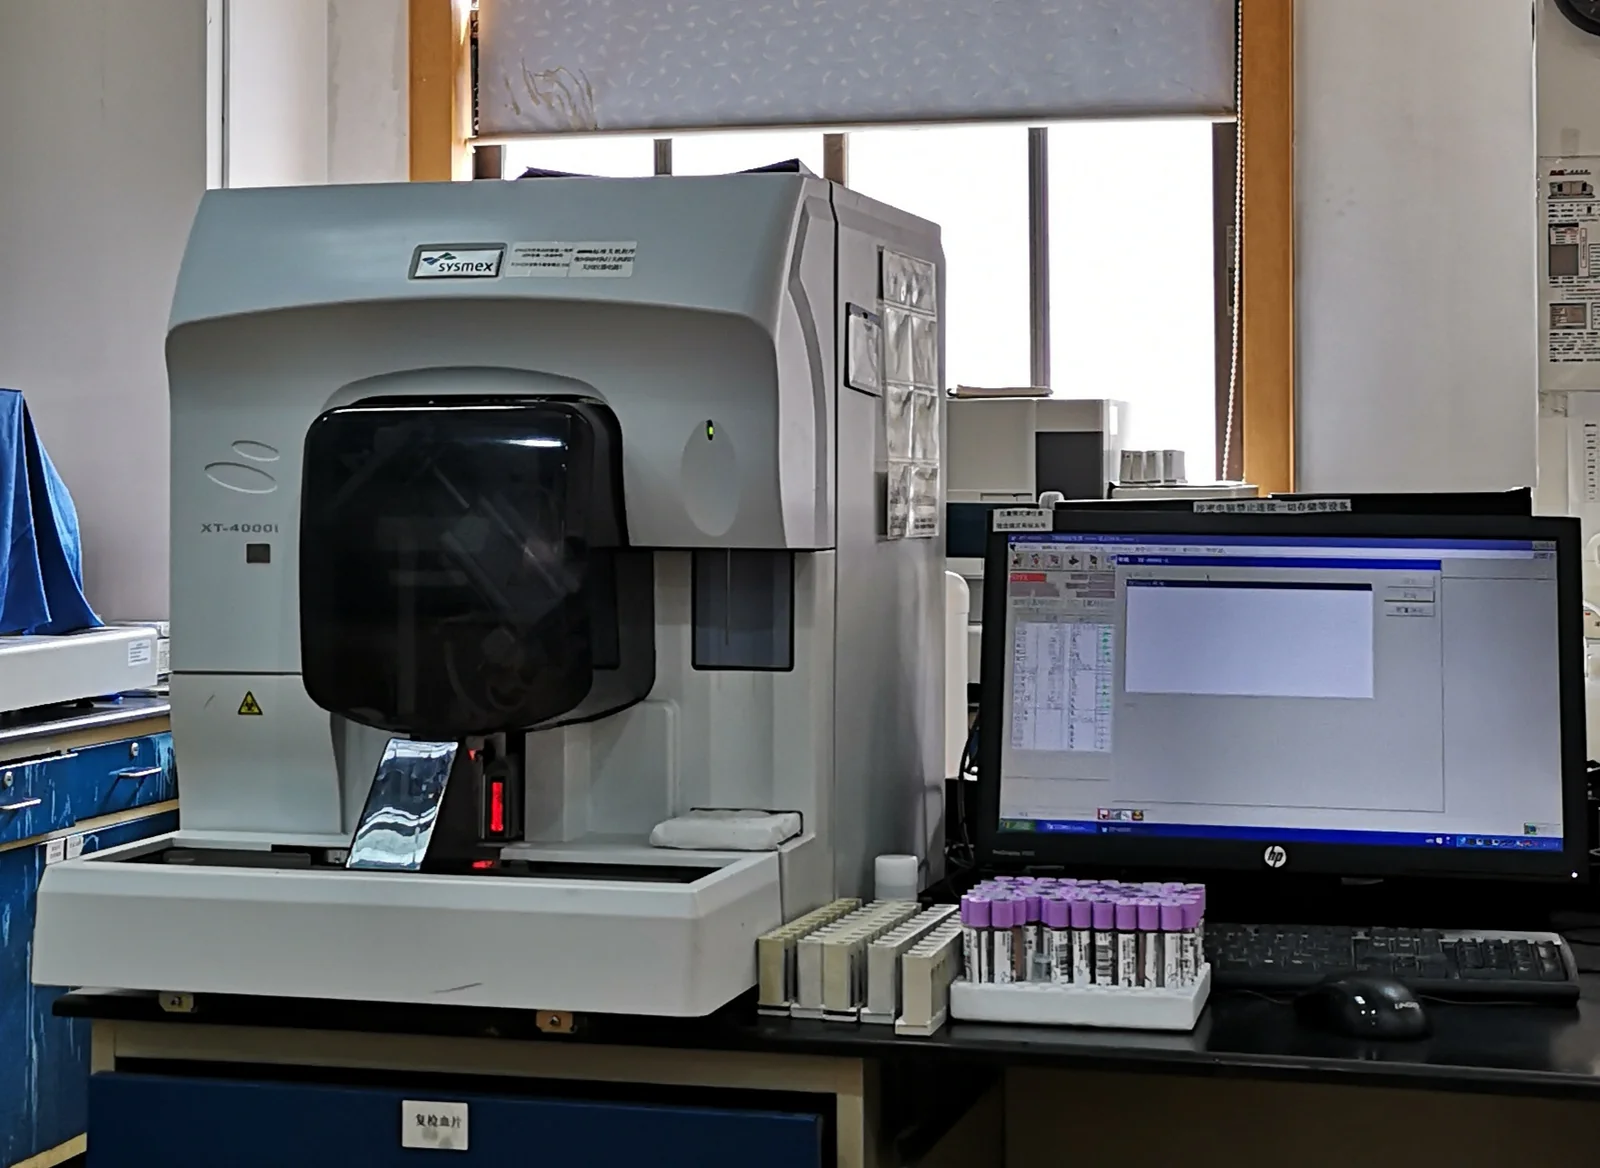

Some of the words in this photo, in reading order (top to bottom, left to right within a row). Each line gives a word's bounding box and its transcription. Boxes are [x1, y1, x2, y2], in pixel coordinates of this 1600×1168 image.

[438, 261, 494, 272] sysmex
[1264, 845, 1287, 868] hp
[416, 1113, 461, 1129] 复检血片
